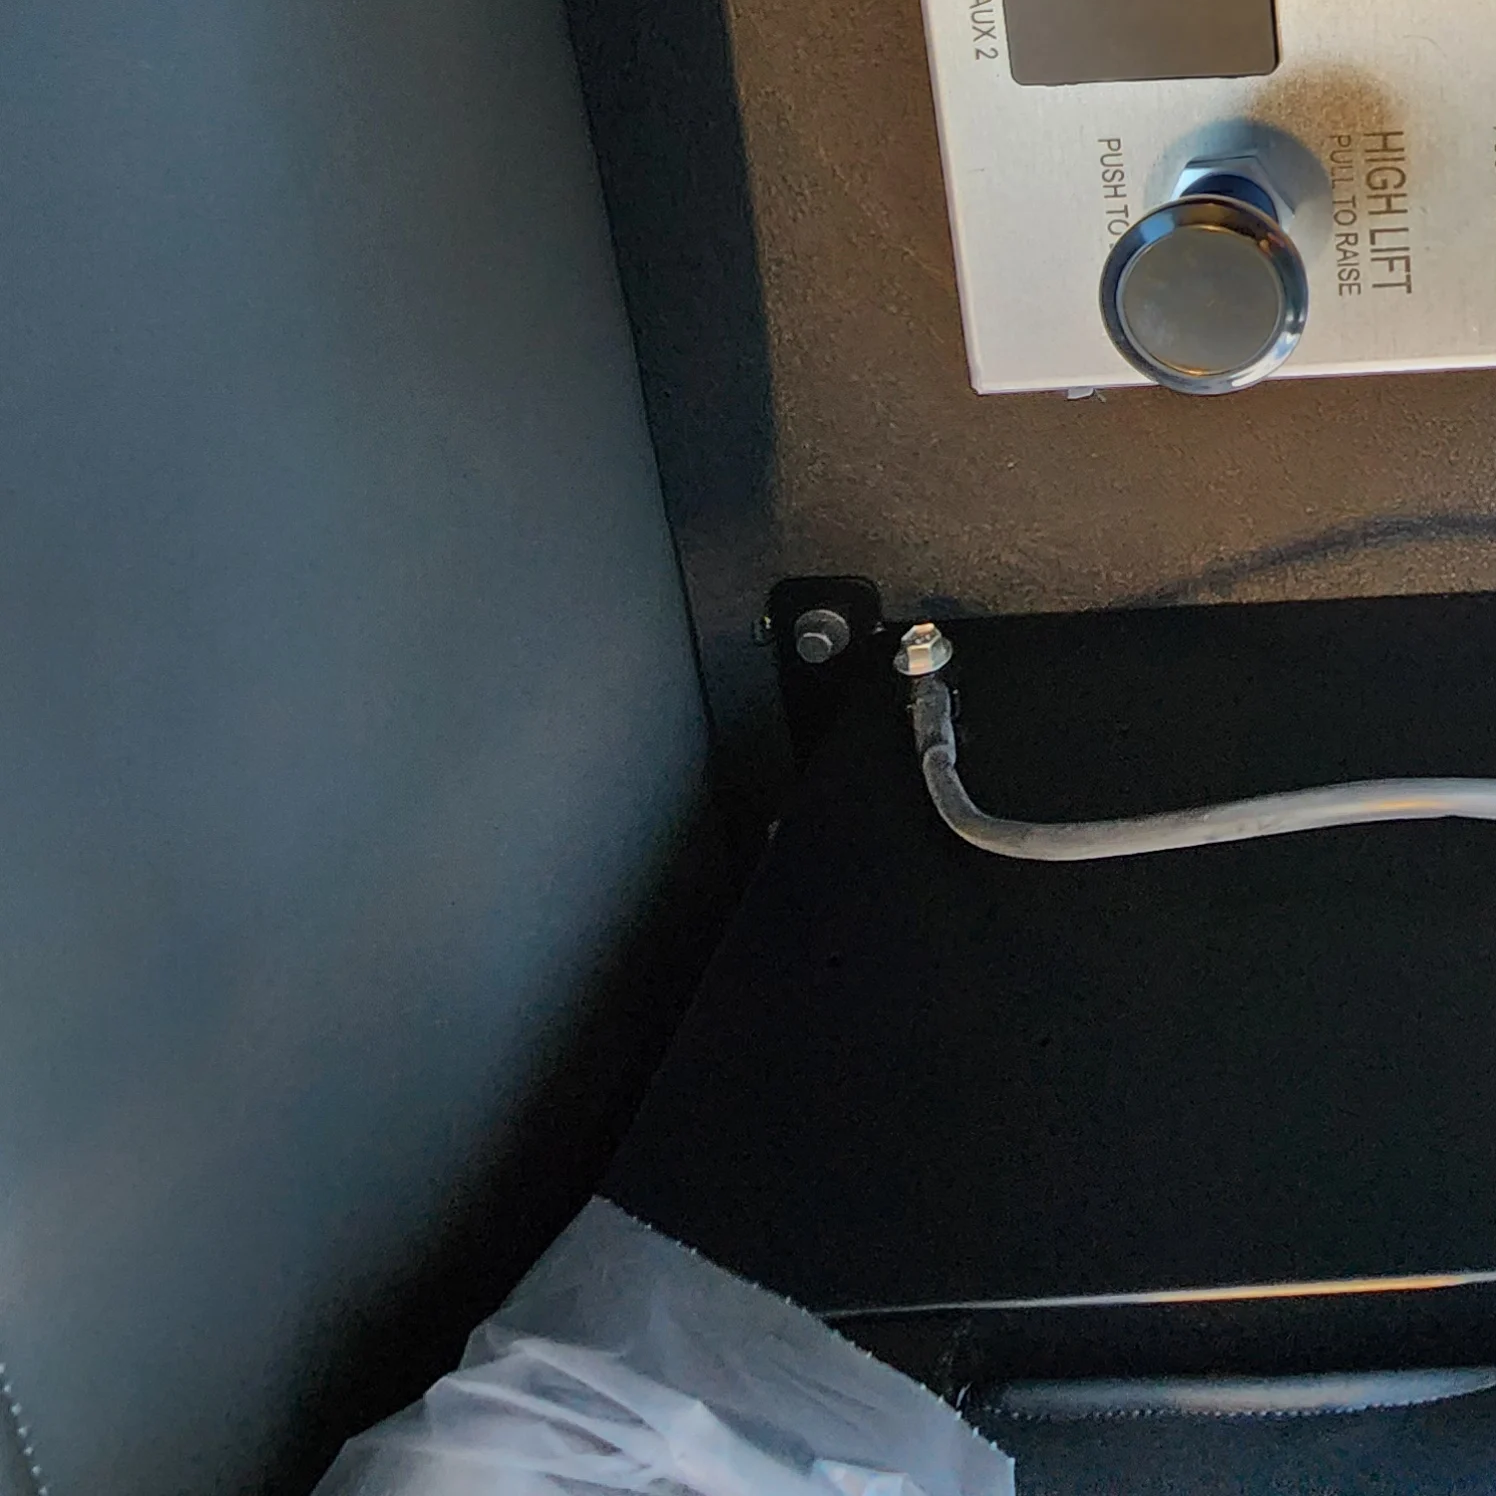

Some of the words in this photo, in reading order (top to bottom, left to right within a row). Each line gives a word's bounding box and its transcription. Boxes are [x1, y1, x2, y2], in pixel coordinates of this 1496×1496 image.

[975, 44, 998, 61] 2
[1098, 137, 1127, 198] PUSH
[1329, 134, 1354, 189] PULL
[1364, 130, 1408, 215] HIGH
[1104, 203, 1130, 236] TO
[1333, 195, 1358, 226] TO
[1335, 233, 1361, 297] RAISE
[1370, 227, 1412, 294] LIFT
